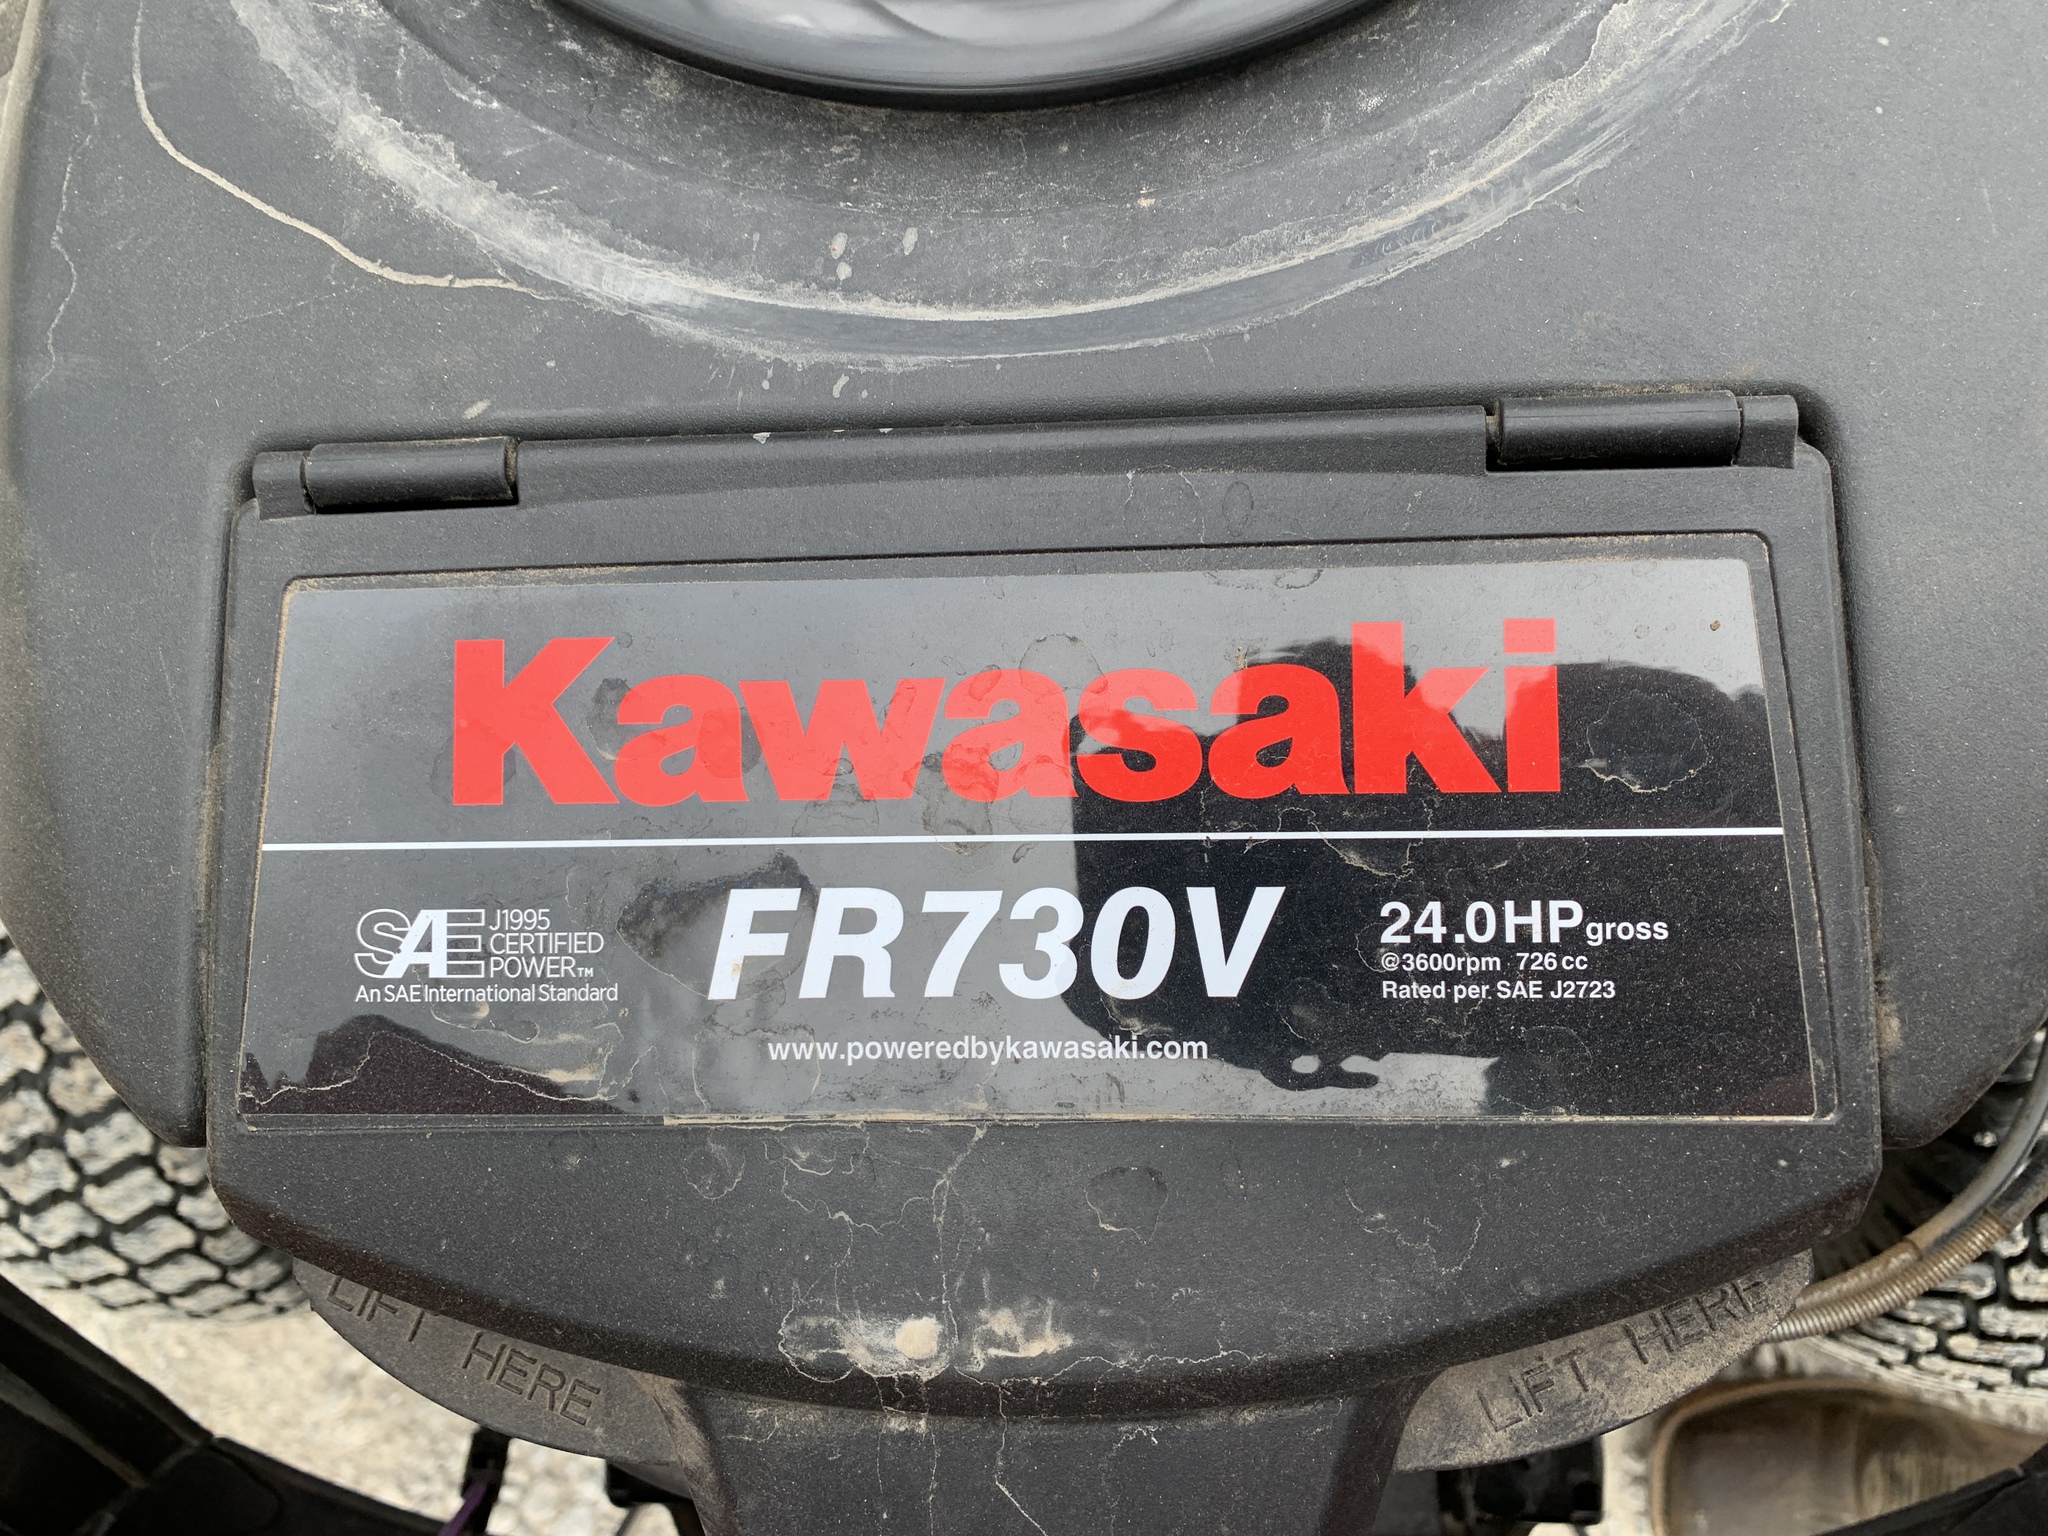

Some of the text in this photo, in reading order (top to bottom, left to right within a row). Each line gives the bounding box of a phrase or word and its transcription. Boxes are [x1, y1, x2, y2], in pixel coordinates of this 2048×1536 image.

[451, 617, 1563, 807] Kawasaki
[489, 908, 551, 931] J1995
[1585, 920, 1670, 946] gross
[354, 908, 486, 979] SAE
[489, 932, 605, 954] CERTIFIED
[707, 885, 1287, 1000] FR730V
[1381, 951, 1502, 976] @3600rpm
[355, 983, 619, 1003] An SAE International Standard
[1382, 981, 1616, 1003] Rated per SAE J2723
[767, 1035, 1209, 1067] www.poweredbykawasaki.com
[1476, 1278, 1771, 1432] LIFT HERE
[461, 1331, 601, 1426] HERE
